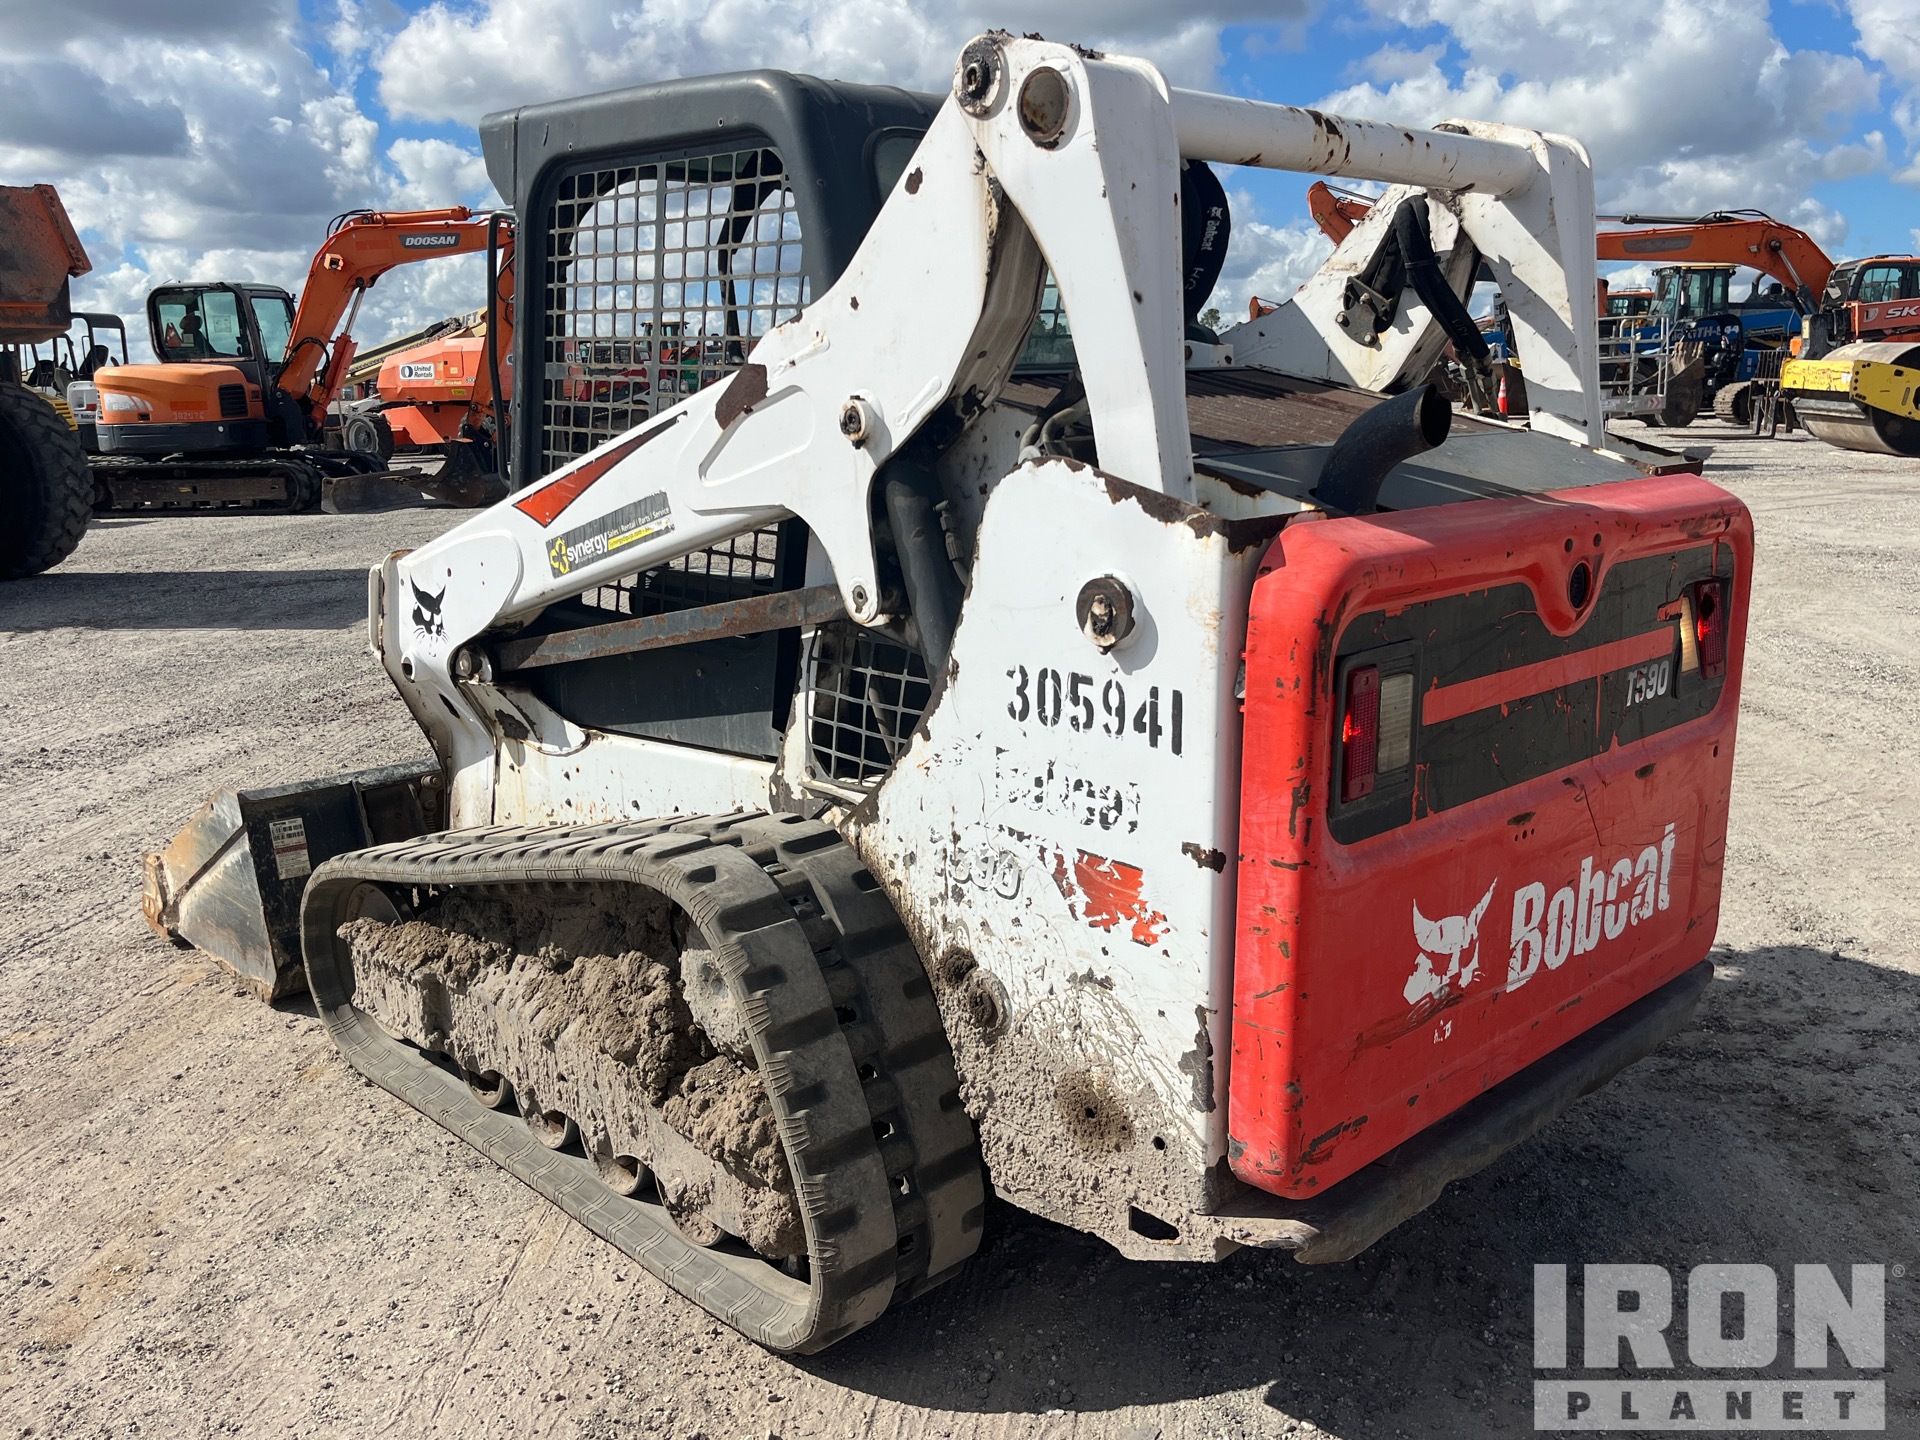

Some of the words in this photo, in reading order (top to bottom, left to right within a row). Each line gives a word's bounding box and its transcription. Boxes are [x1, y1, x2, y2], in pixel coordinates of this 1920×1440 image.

[406, 236, 456, 246] DOOSAN
[1201, 221, 1220, 251] Bobcat
[607, 529, 620, 539] Sales
[621, 520, 636, 532] Rental
[638, 515, 651, 525] Parts
[653, 507, 670, 519] Service
[566, 532, 608, 564] synergy
[1626, 660, 1670, 706] T590
[1006, 664, 1183, 757] 305941
[1506, 823, 1676, 993] Bobcat
